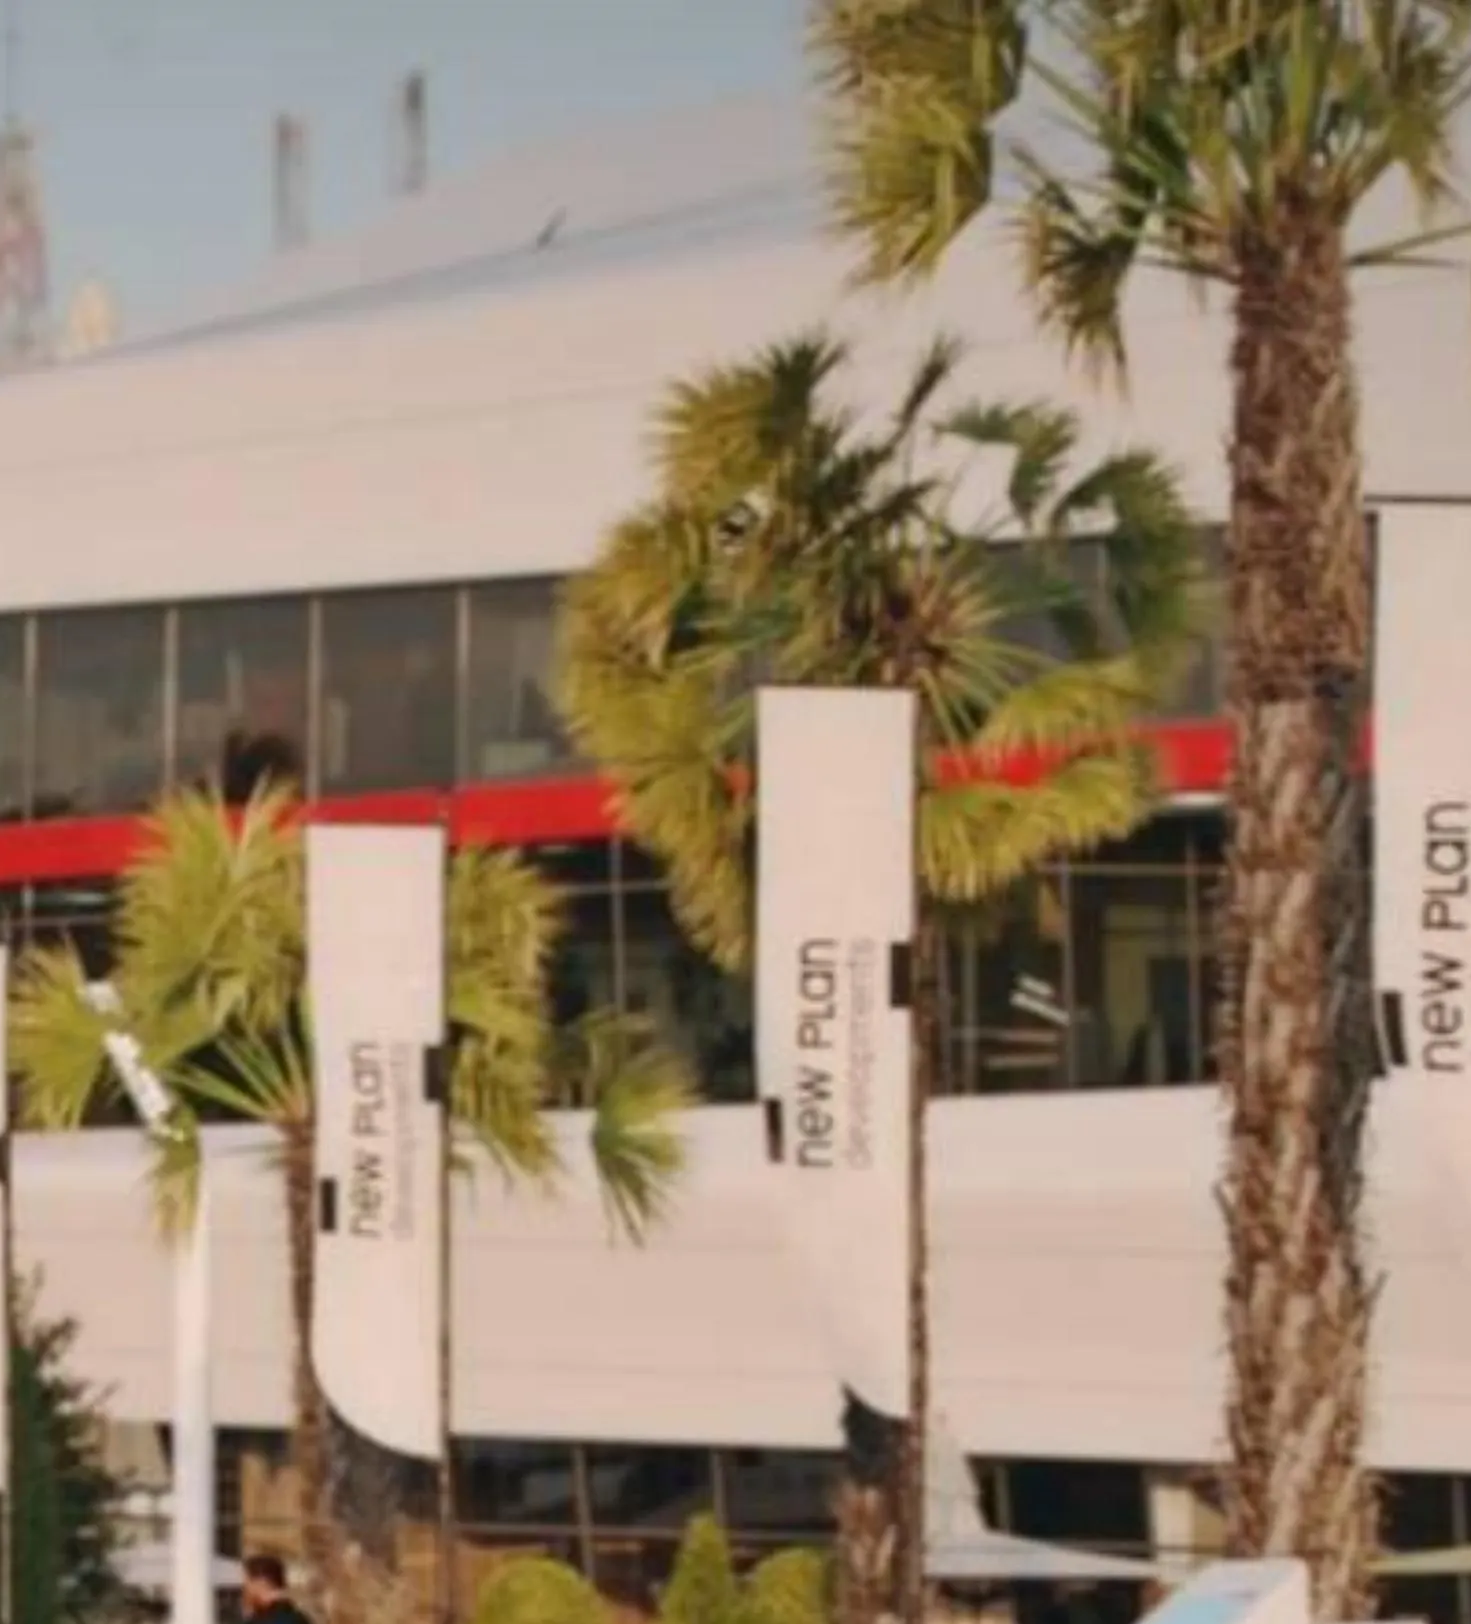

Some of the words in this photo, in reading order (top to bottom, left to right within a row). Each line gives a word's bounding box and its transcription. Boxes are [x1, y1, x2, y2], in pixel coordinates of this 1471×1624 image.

[1417, 954, 1464, 1073] new
[792, 1067, 834, 1169] new
[348, 1150, 384, 1239] new
